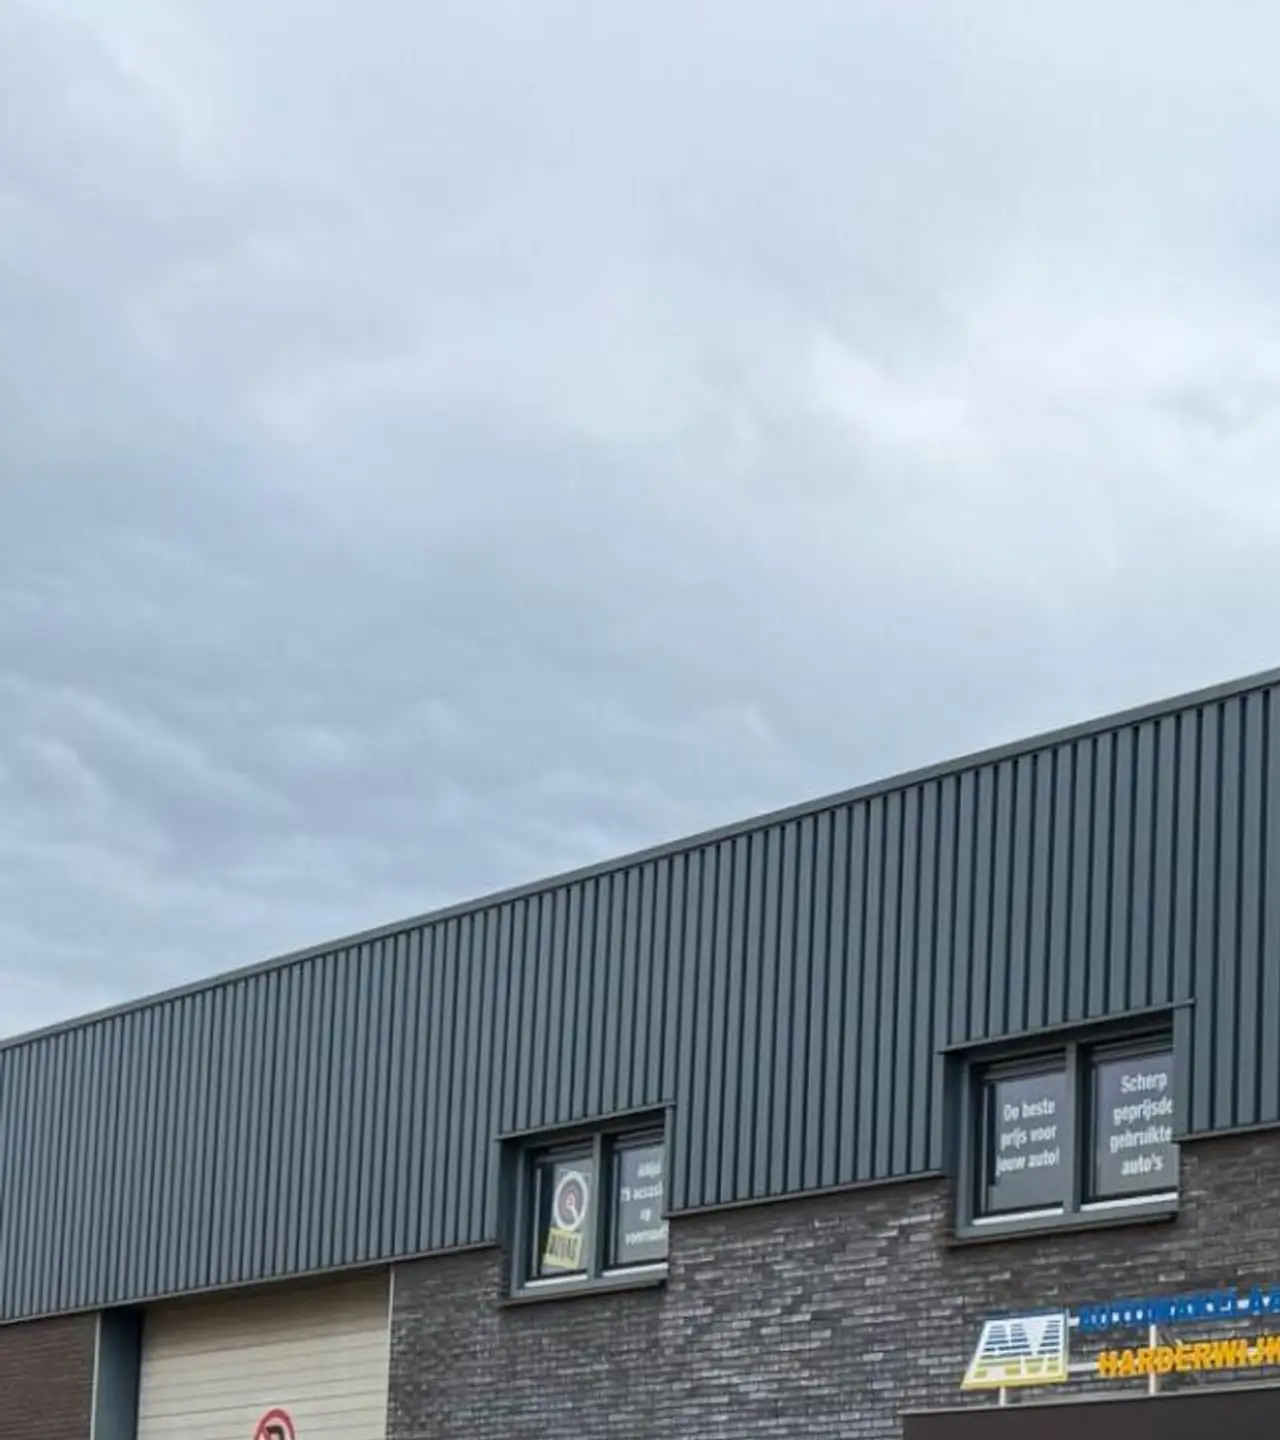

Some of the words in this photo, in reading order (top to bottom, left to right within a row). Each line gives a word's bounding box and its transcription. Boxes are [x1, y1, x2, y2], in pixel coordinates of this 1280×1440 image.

[1121, 1072, 1168, 1094] Scherp
[1003, 1104, 1019, 1121] De
[1022, 1098, 1056, 1118] beste
[1001, 1128, 1028, 1150] prijs
[1030, 1125, 1057, 1142] voor
[1121, 1153, 1164, 1177] auto's
